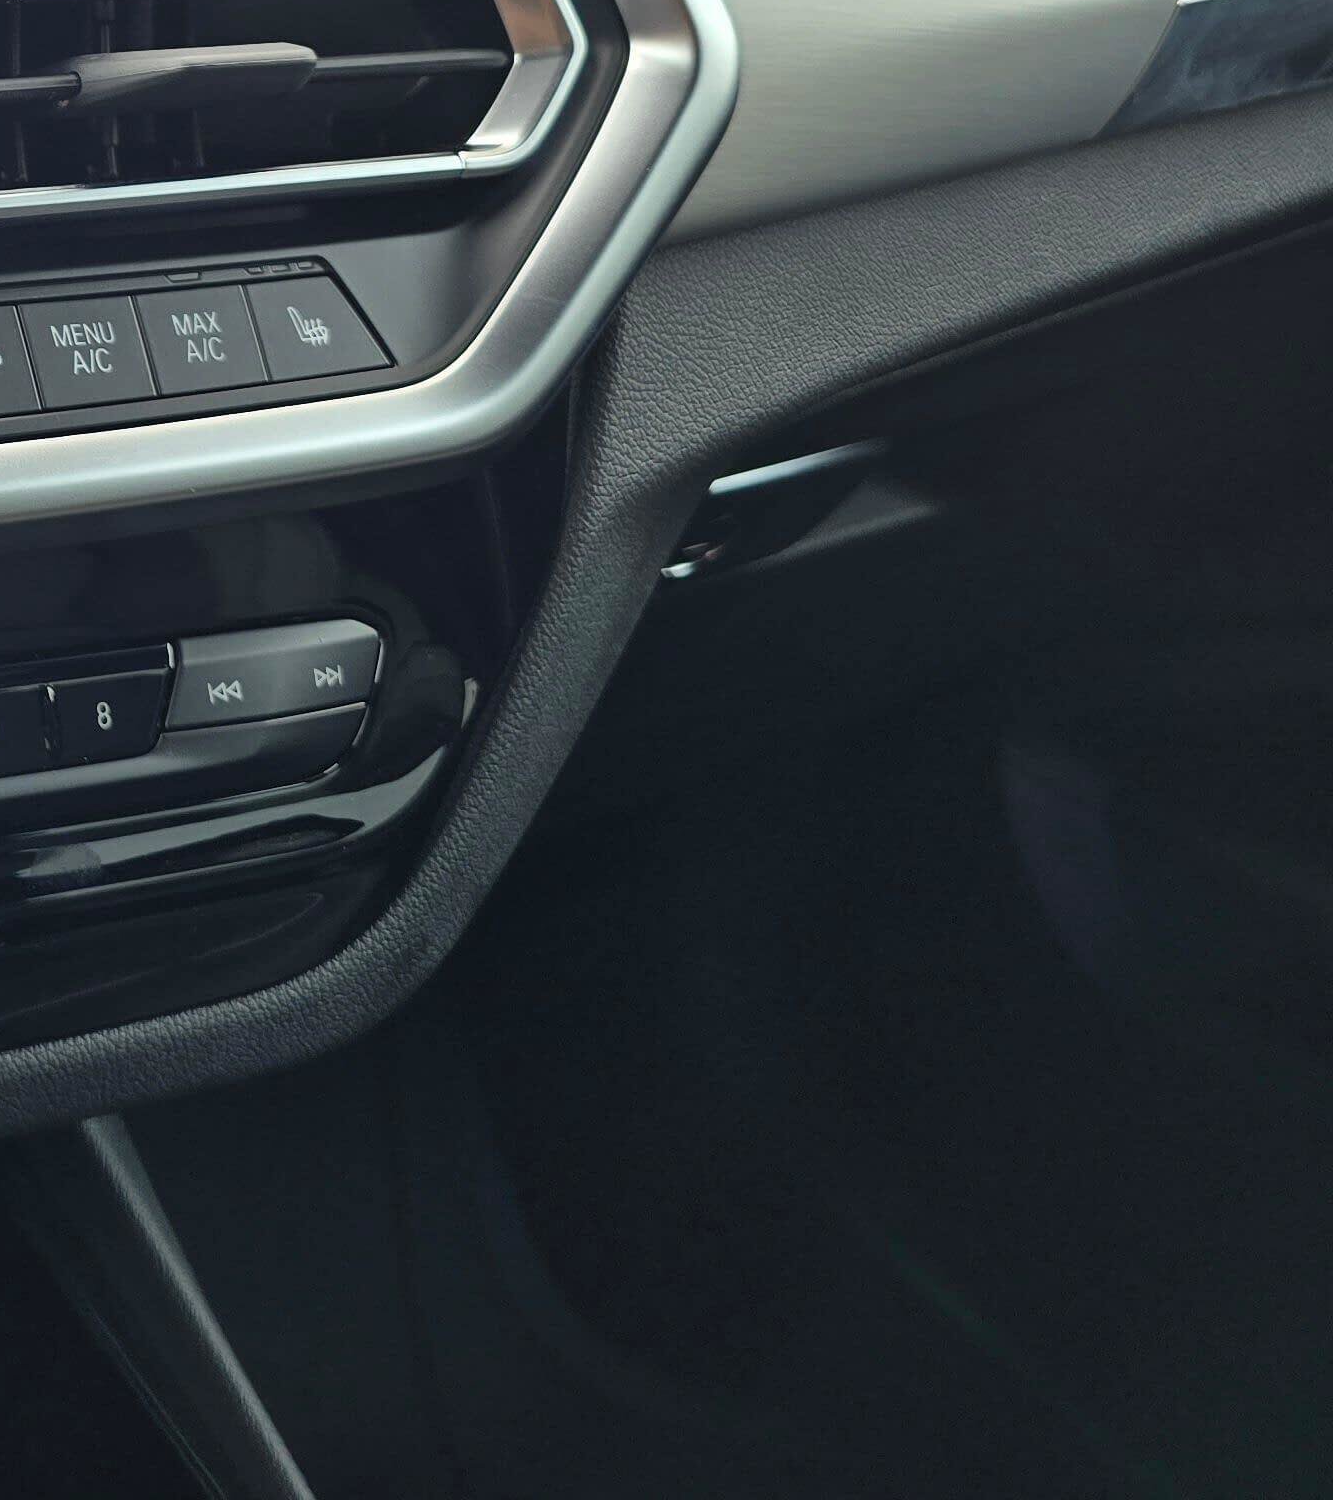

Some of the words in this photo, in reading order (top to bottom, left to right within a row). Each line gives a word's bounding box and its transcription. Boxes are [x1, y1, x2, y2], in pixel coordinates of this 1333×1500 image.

[50, 321, 116, 348] MENU
[172, 310, 223, 335] MAX
[72, 348, 114, 376] A/C
[186, 337, 226, 364] A/C
[96, 701, 112, 729] 8
